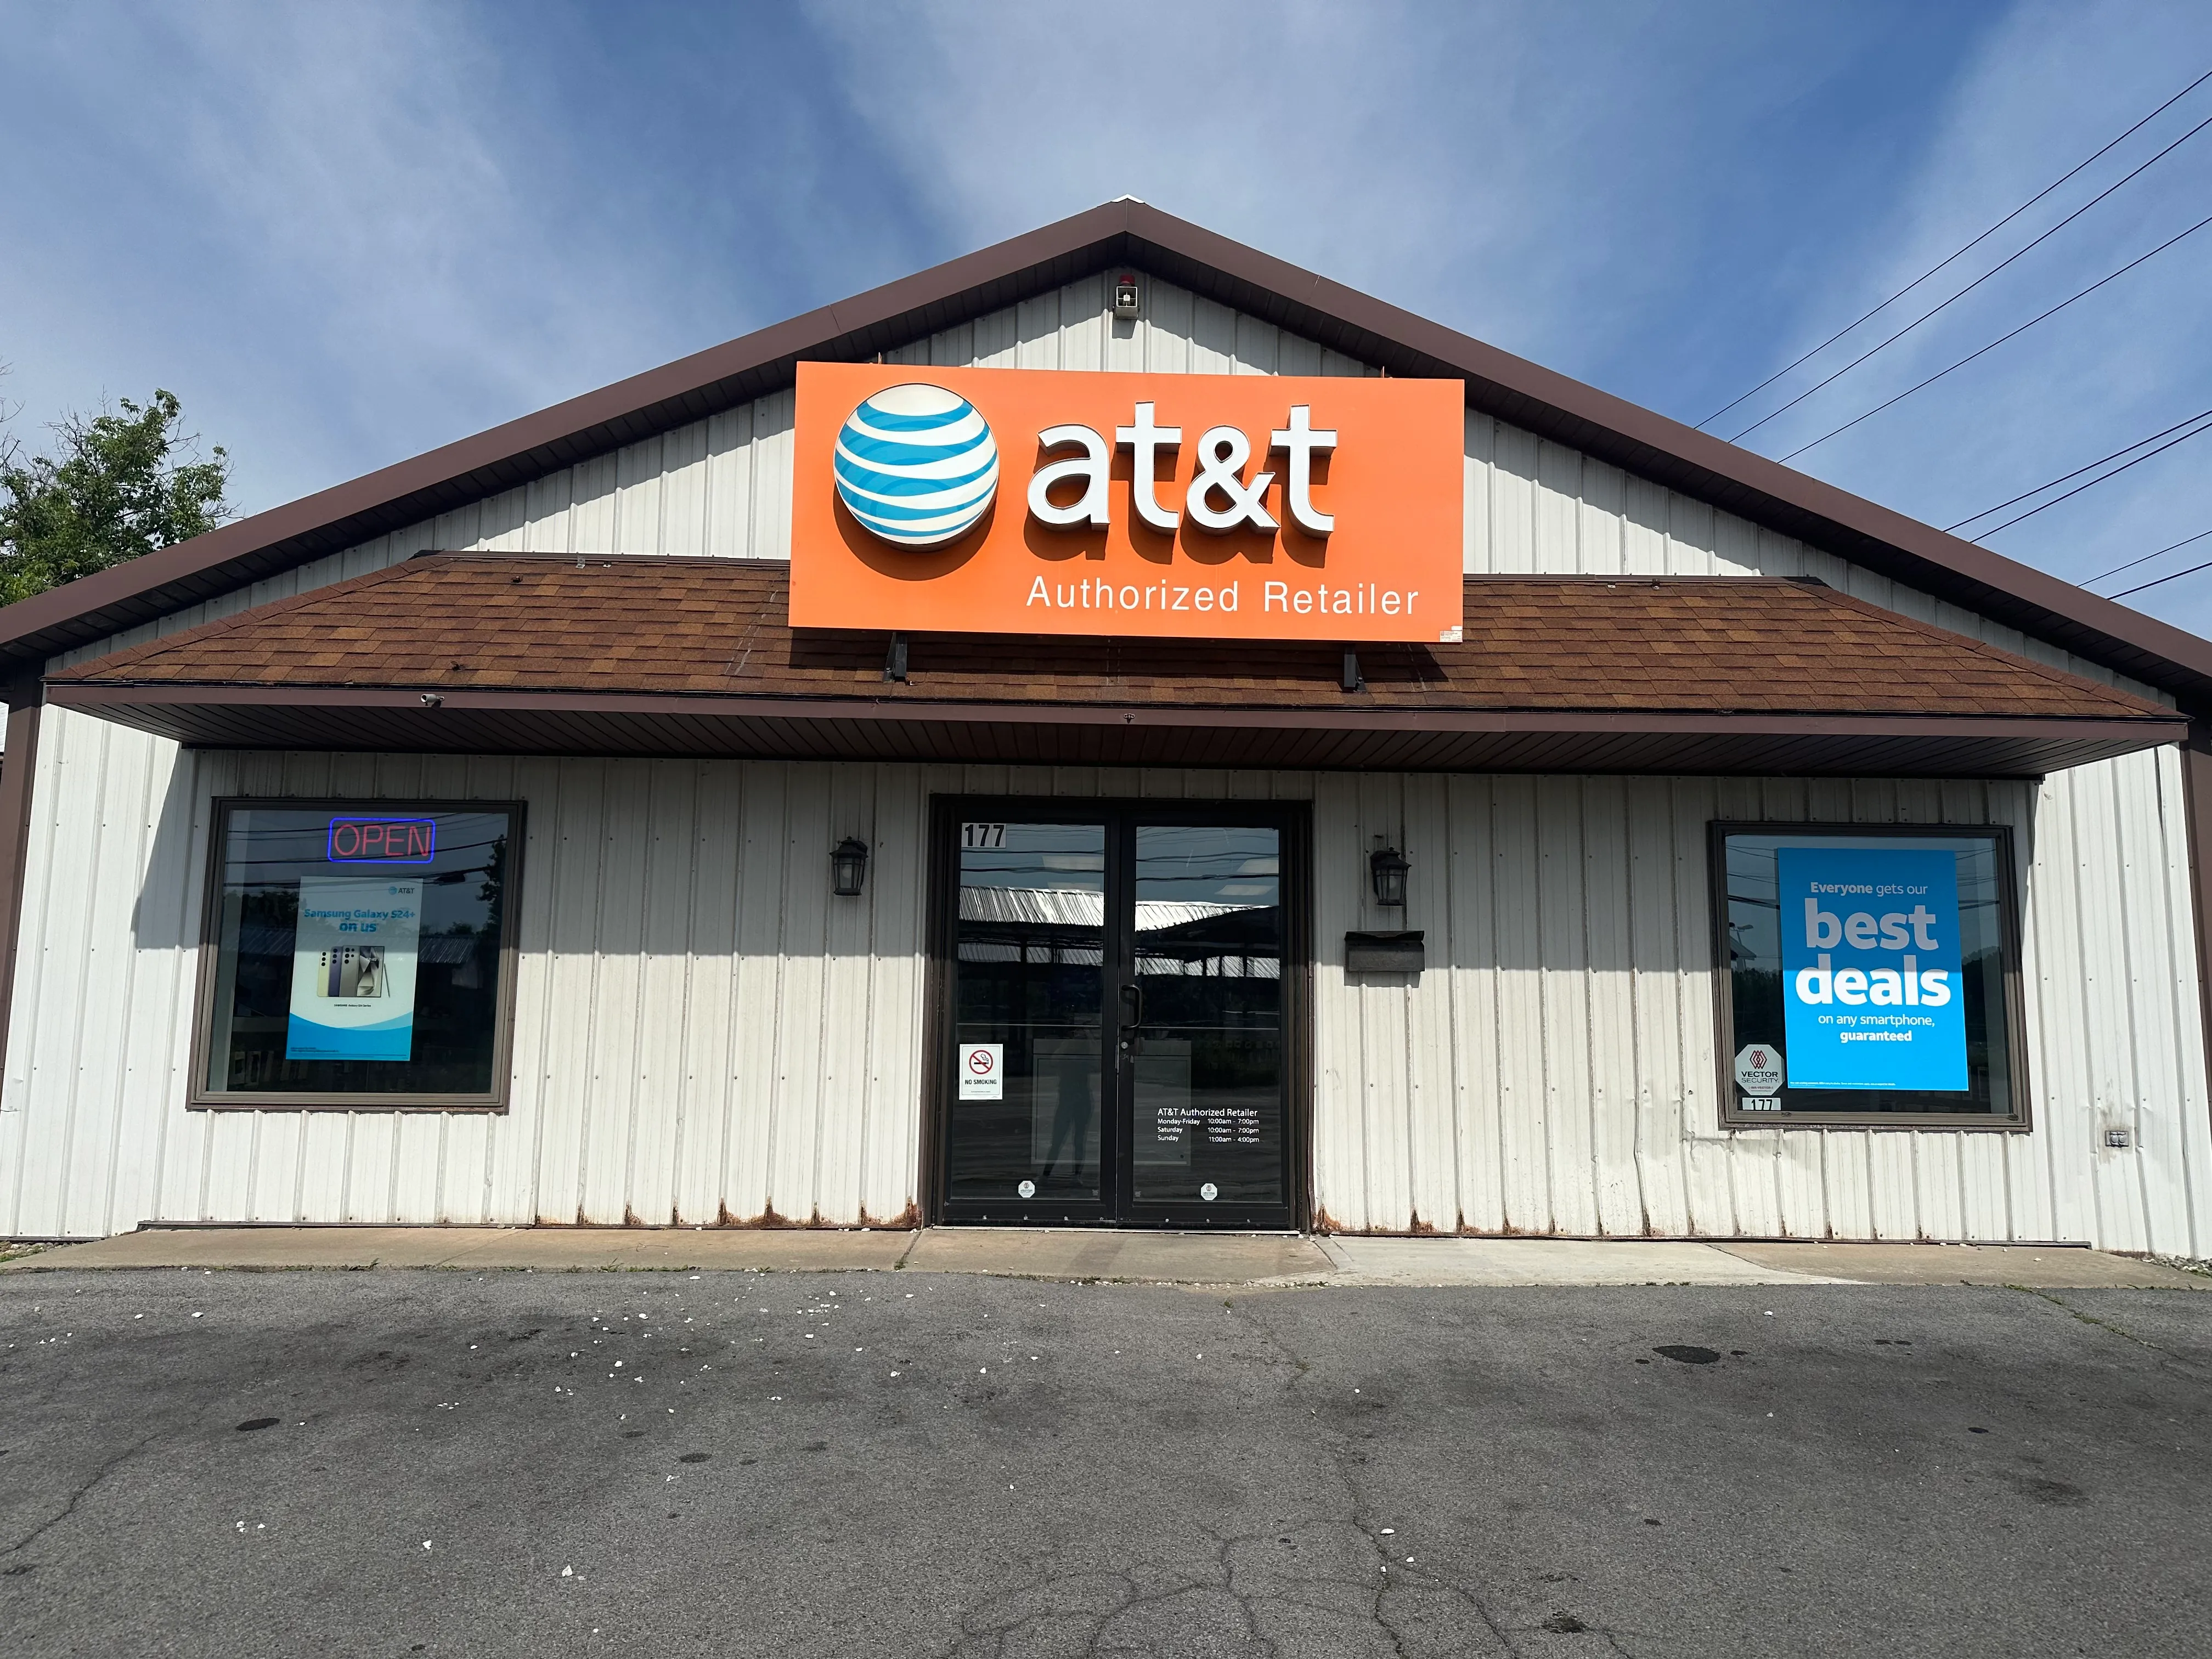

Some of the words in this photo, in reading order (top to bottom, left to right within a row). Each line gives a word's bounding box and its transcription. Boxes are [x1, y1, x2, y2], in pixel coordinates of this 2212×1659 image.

[1028, 400, 1338, 538] at&t
[1026, 575, 1239, 612] Authorized
[1264, 581, 1419, 614] Retailer
[335, 824, 431, 856] OPEN
[965, 824, 1005, 847] 177
[1810, 882, 1873, 896] Everyone
[1876, 884, 1904, 897] gets
[1906, 885, 1928, 894] our
[304, 909, 351, 920] Samsung
[353, 909, 389, 920] Galaxy
[391, 910, 416, 918] S24+
[339, 923, 357, 932] on
[360, 923, 377, 932] us
[1804, 898, 1939, 950] best
[1796, 953, 1951, 1007] deals
[1818, 1015, 1833, 1024] on
[1836, 1015, 1857, 1028] any
[1860, 1014, 1935, 1028] smartphone,
[1840, 1030, 1912, 1043] guaranteed
[1180, 1108, 1224, 1116] Authorized
[1751, 1099, 1773, 1110] 177
